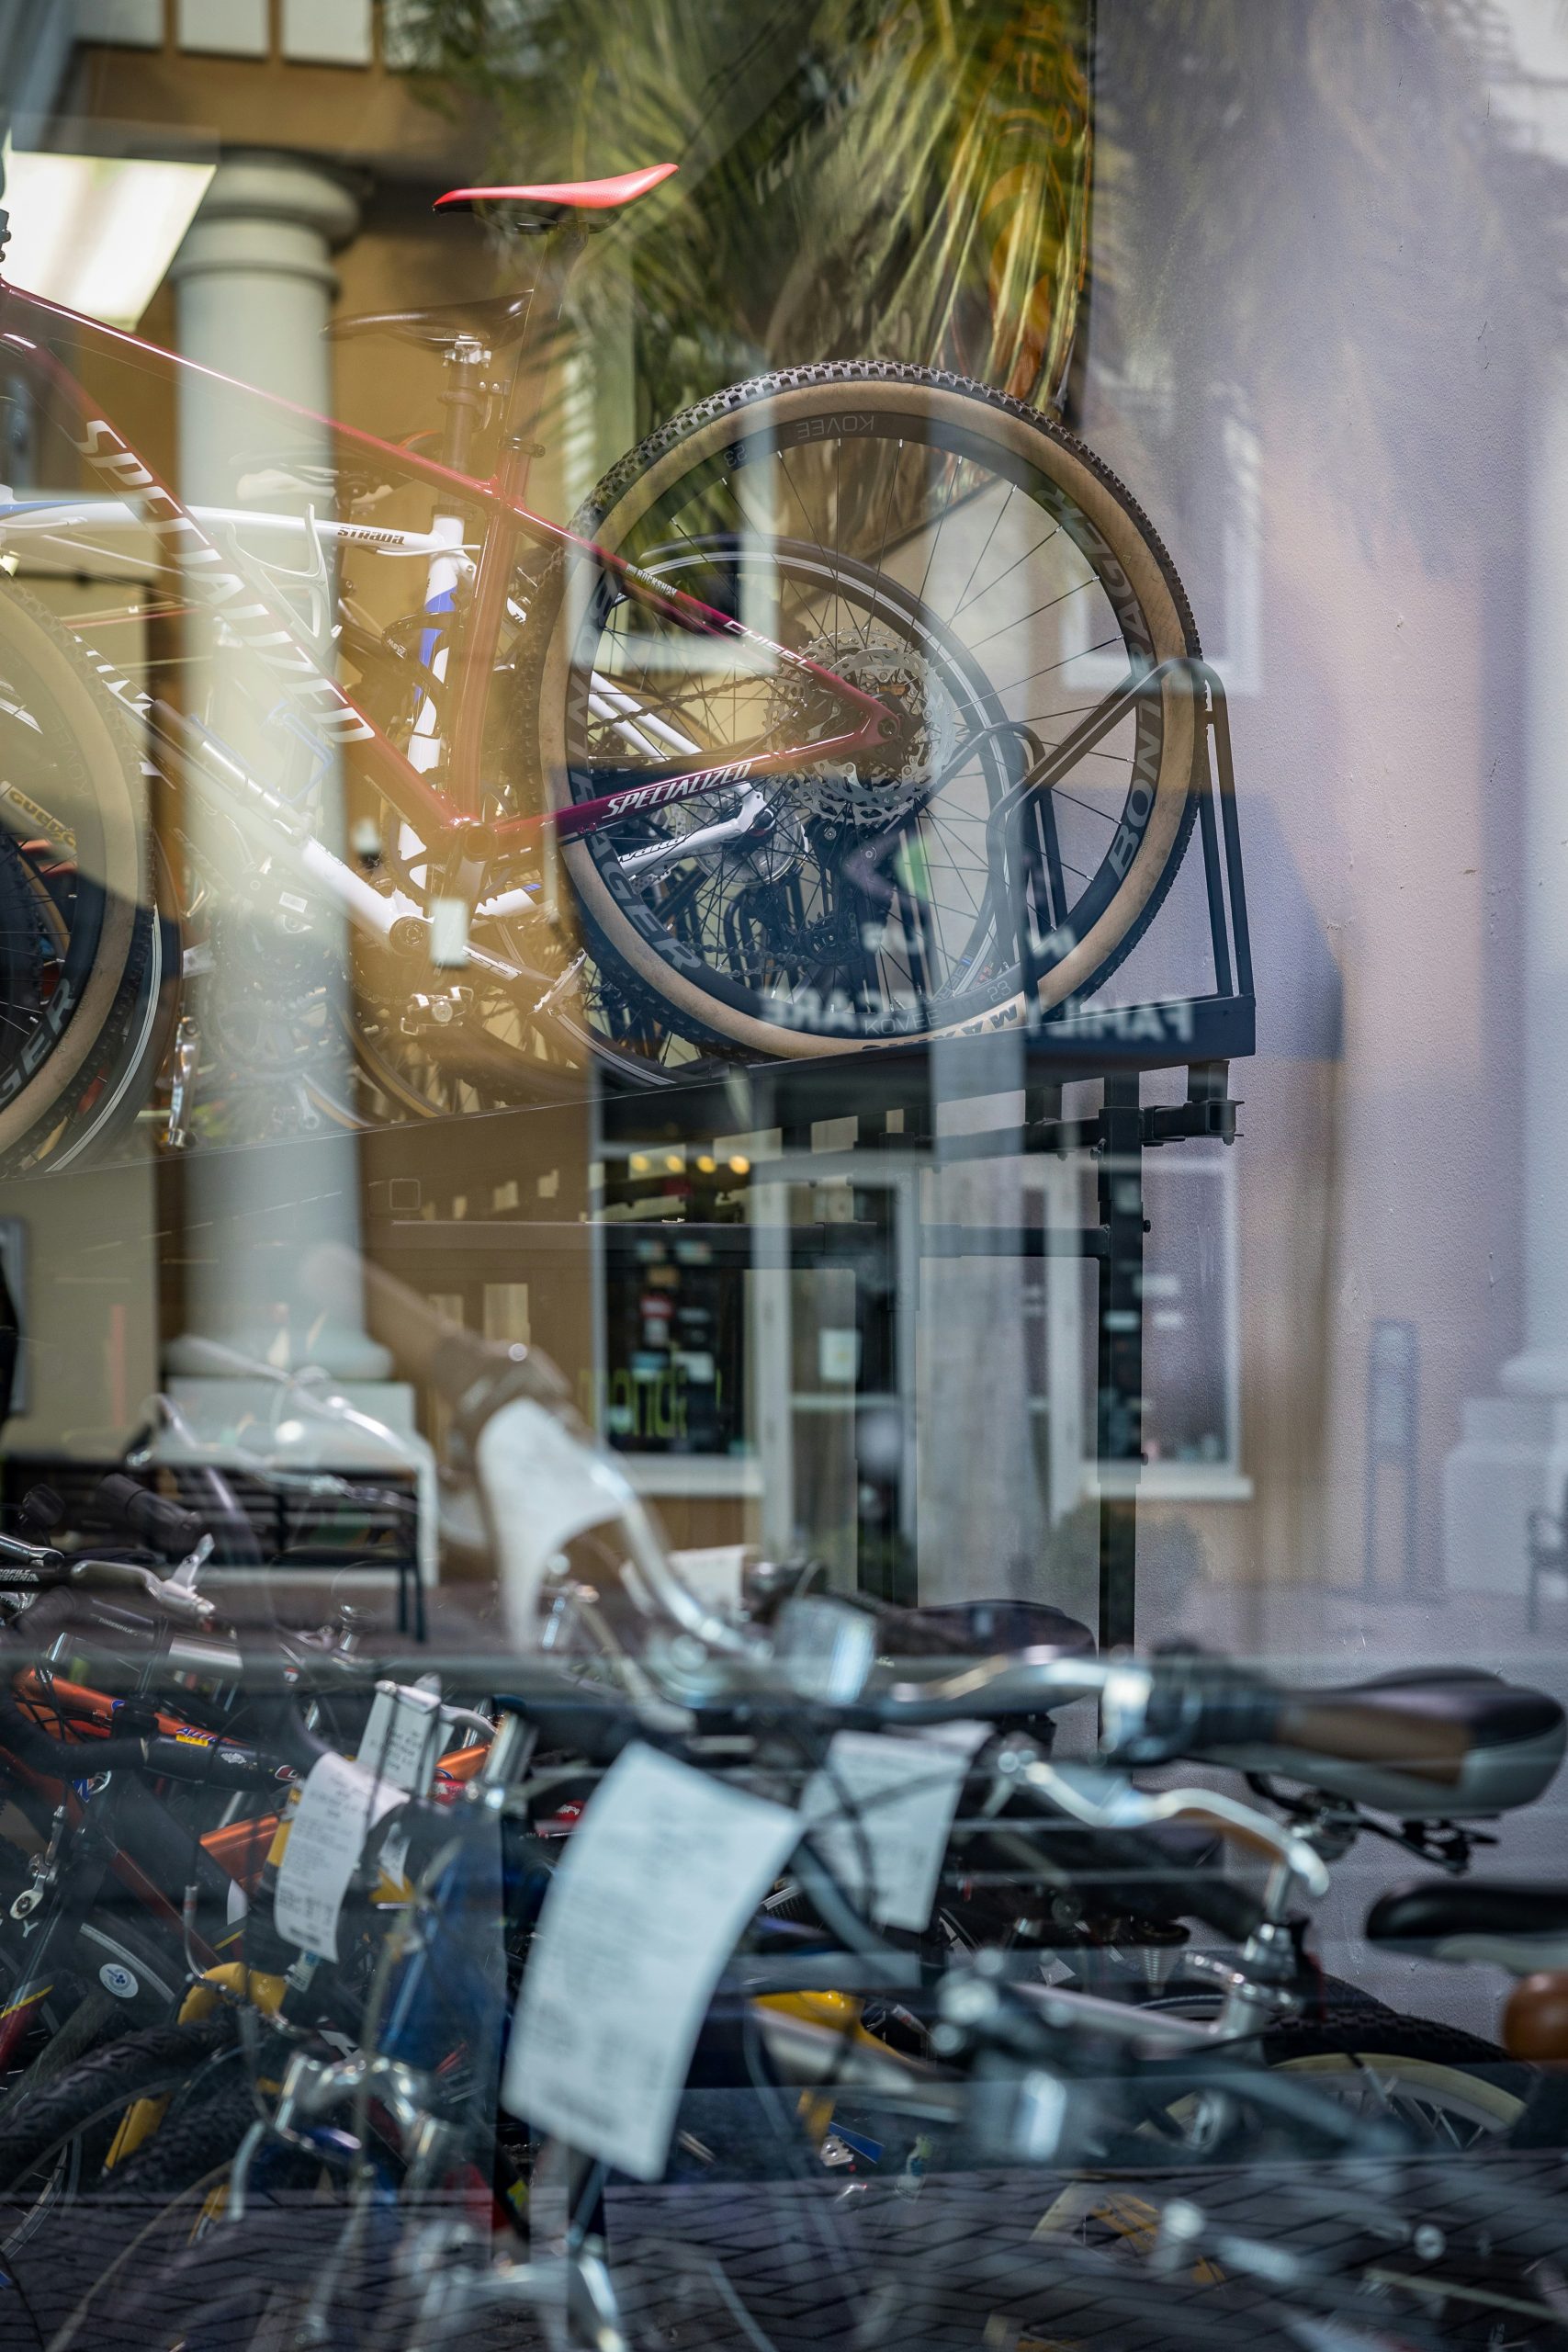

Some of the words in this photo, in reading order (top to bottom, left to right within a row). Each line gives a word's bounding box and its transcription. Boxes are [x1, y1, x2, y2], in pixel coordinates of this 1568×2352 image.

[795, 415, 874, 440] KOVEE
[73, 420, 375, 742] SPECIALIZED
[723, 620, 813, 673] CHISEL
[602, 763, 751, 819] SPECIALIZED
[864, 1009, 942, 1035] KOVEE
[987, 979, 1012, 1002] 23
